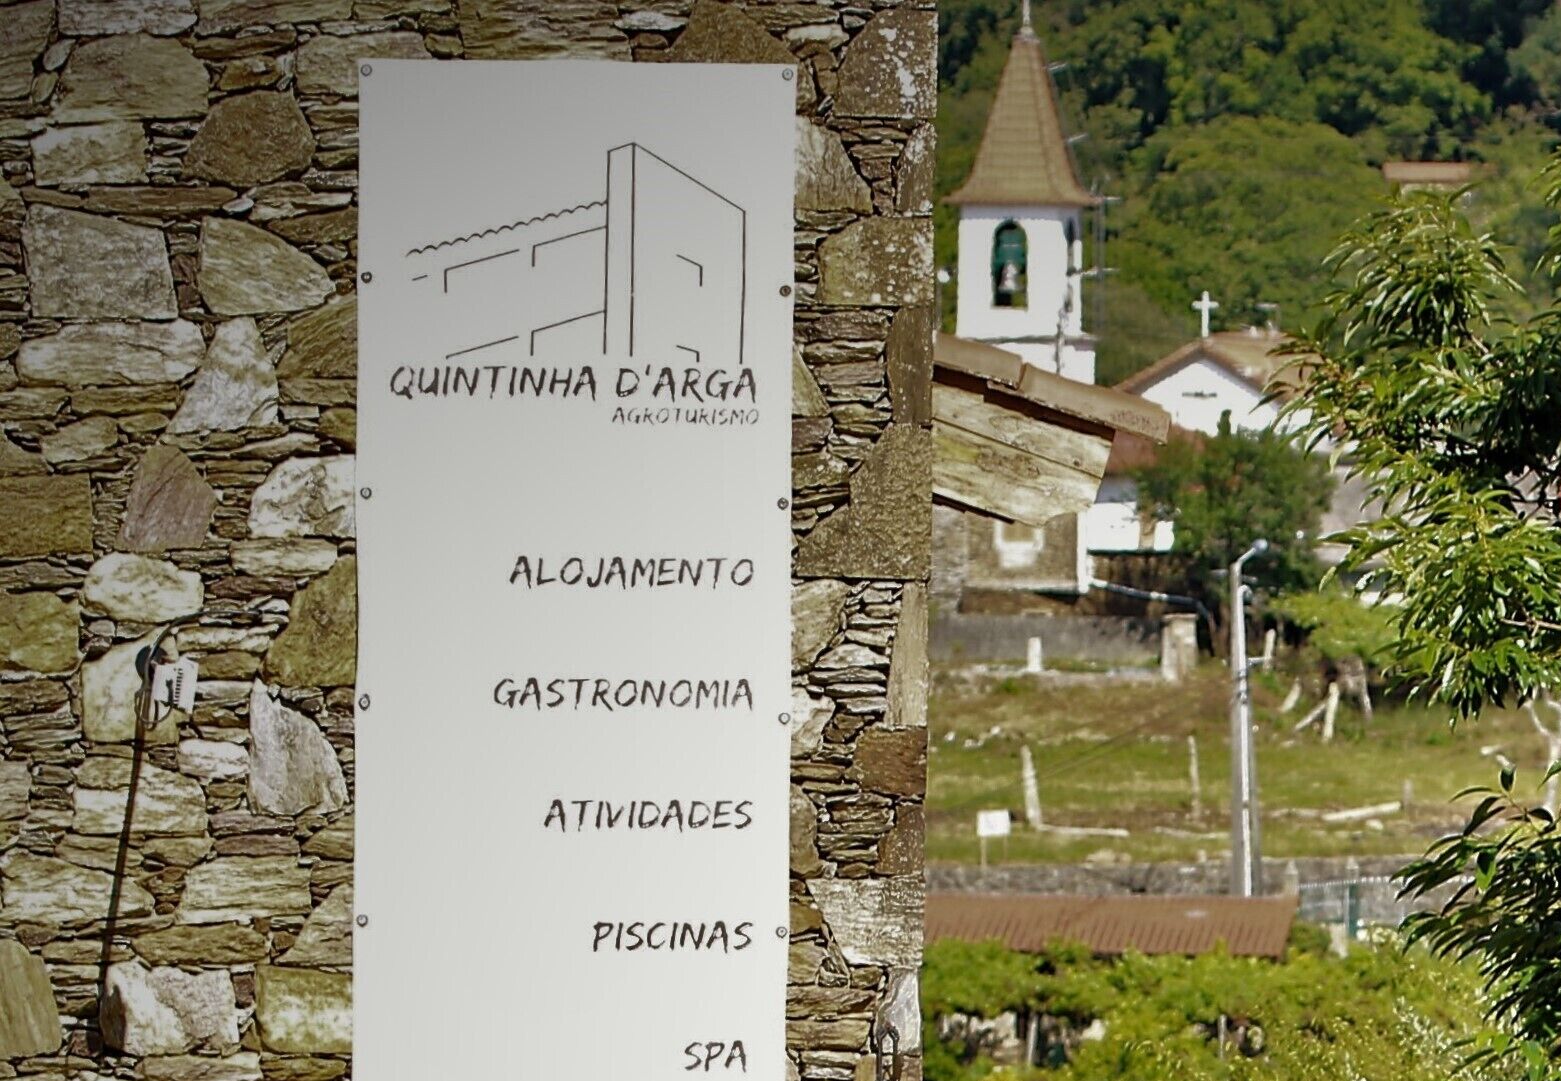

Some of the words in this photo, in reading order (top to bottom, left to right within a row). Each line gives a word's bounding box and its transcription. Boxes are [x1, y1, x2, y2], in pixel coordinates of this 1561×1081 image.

[390, 366, 597, 402] QUINTINHA
[615, 366, 757, 403] D'ARGA
[612, 406, 760, 426] AGROTURISMO
[509, 555, 755, 590] ALOJAMENTO
[493, 677, 753, 712] GASTRONOMIA
[543, 799, 754, 834] ATIVIDADES
[593, 921, 754, 955] PISCINAS
[684, 1040, 748, 1074] SPA
